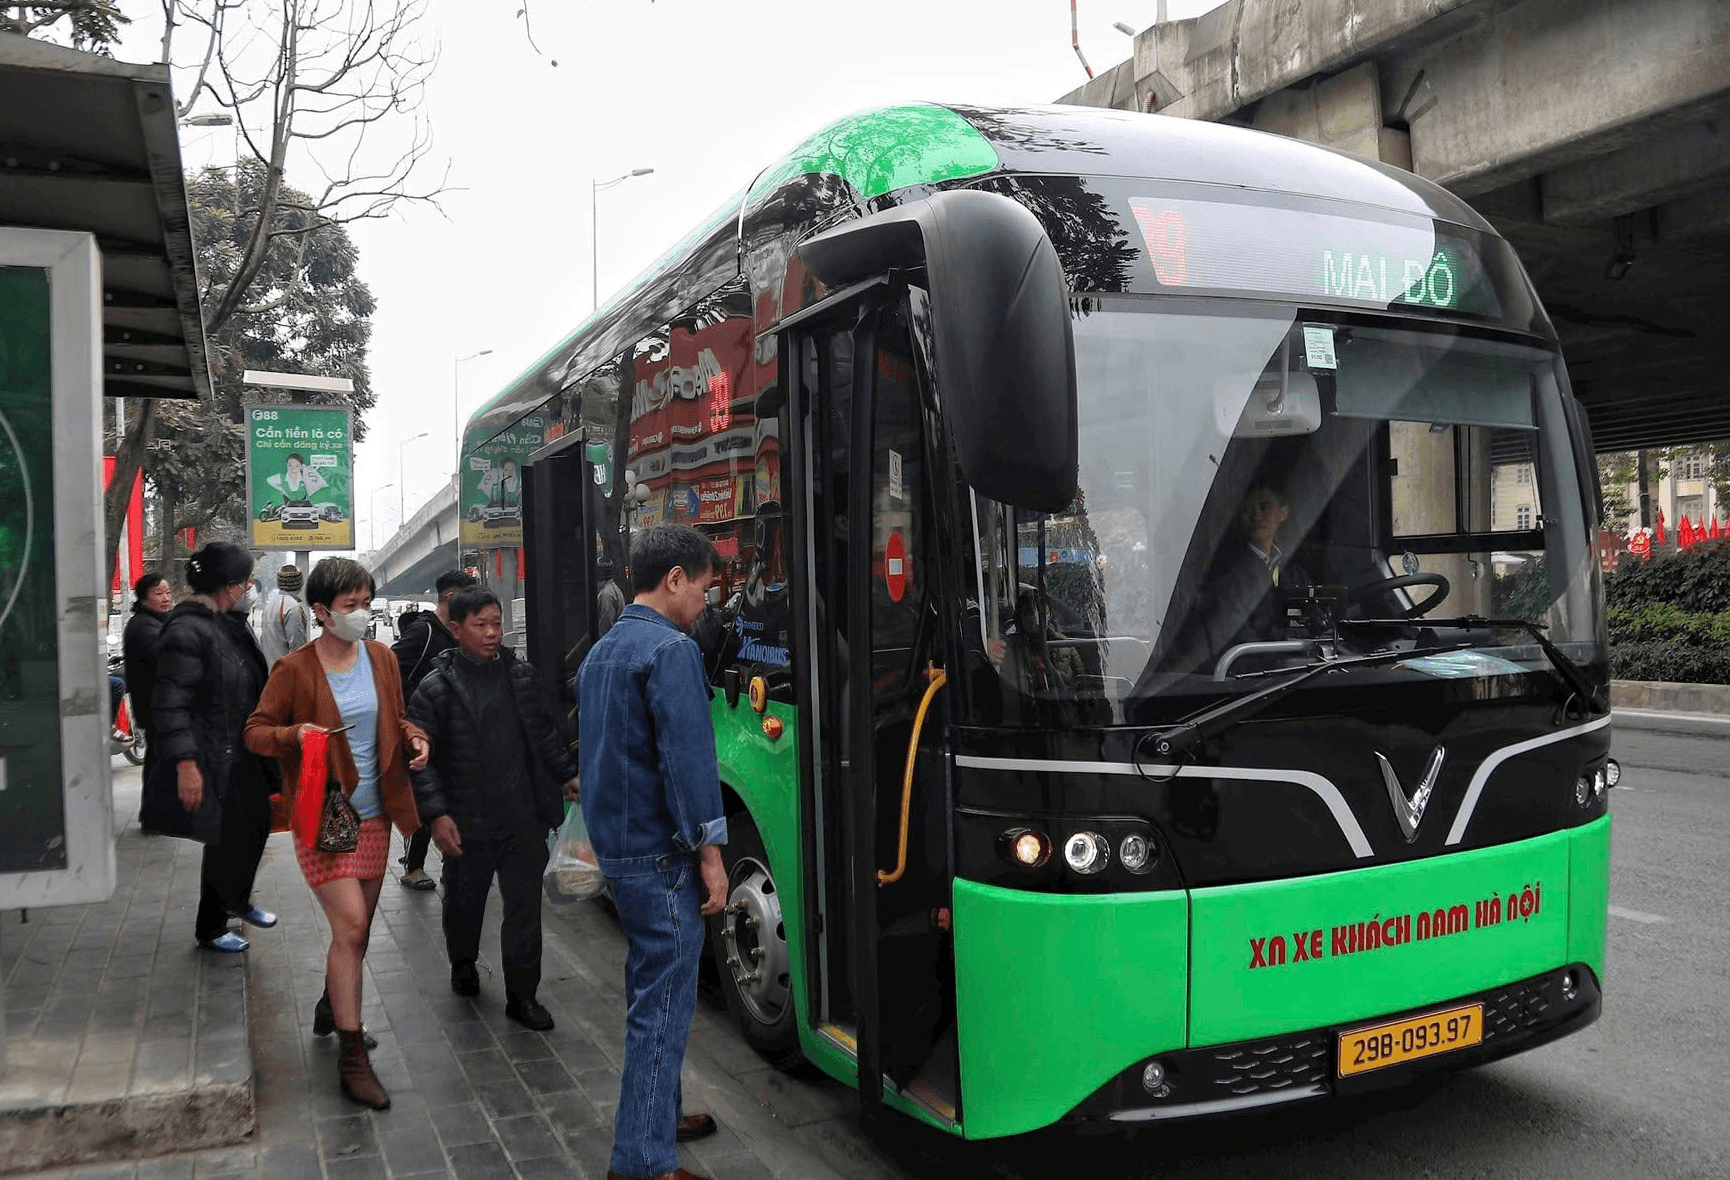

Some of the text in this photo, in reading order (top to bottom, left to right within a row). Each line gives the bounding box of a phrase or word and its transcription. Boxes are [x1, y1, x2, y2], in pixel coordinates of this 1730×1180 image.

[1323, 250, 1453, 306] MAI ĐÔ
[252, 409, 279, 421] F88
[256, 425, 343, 439] Cần tiền là có
[1249, 881, 1540, 969] XN XE KHÁCH NAM HÀ NỘI
[1353, 1014, 1471, 1066] 29B-093.97
